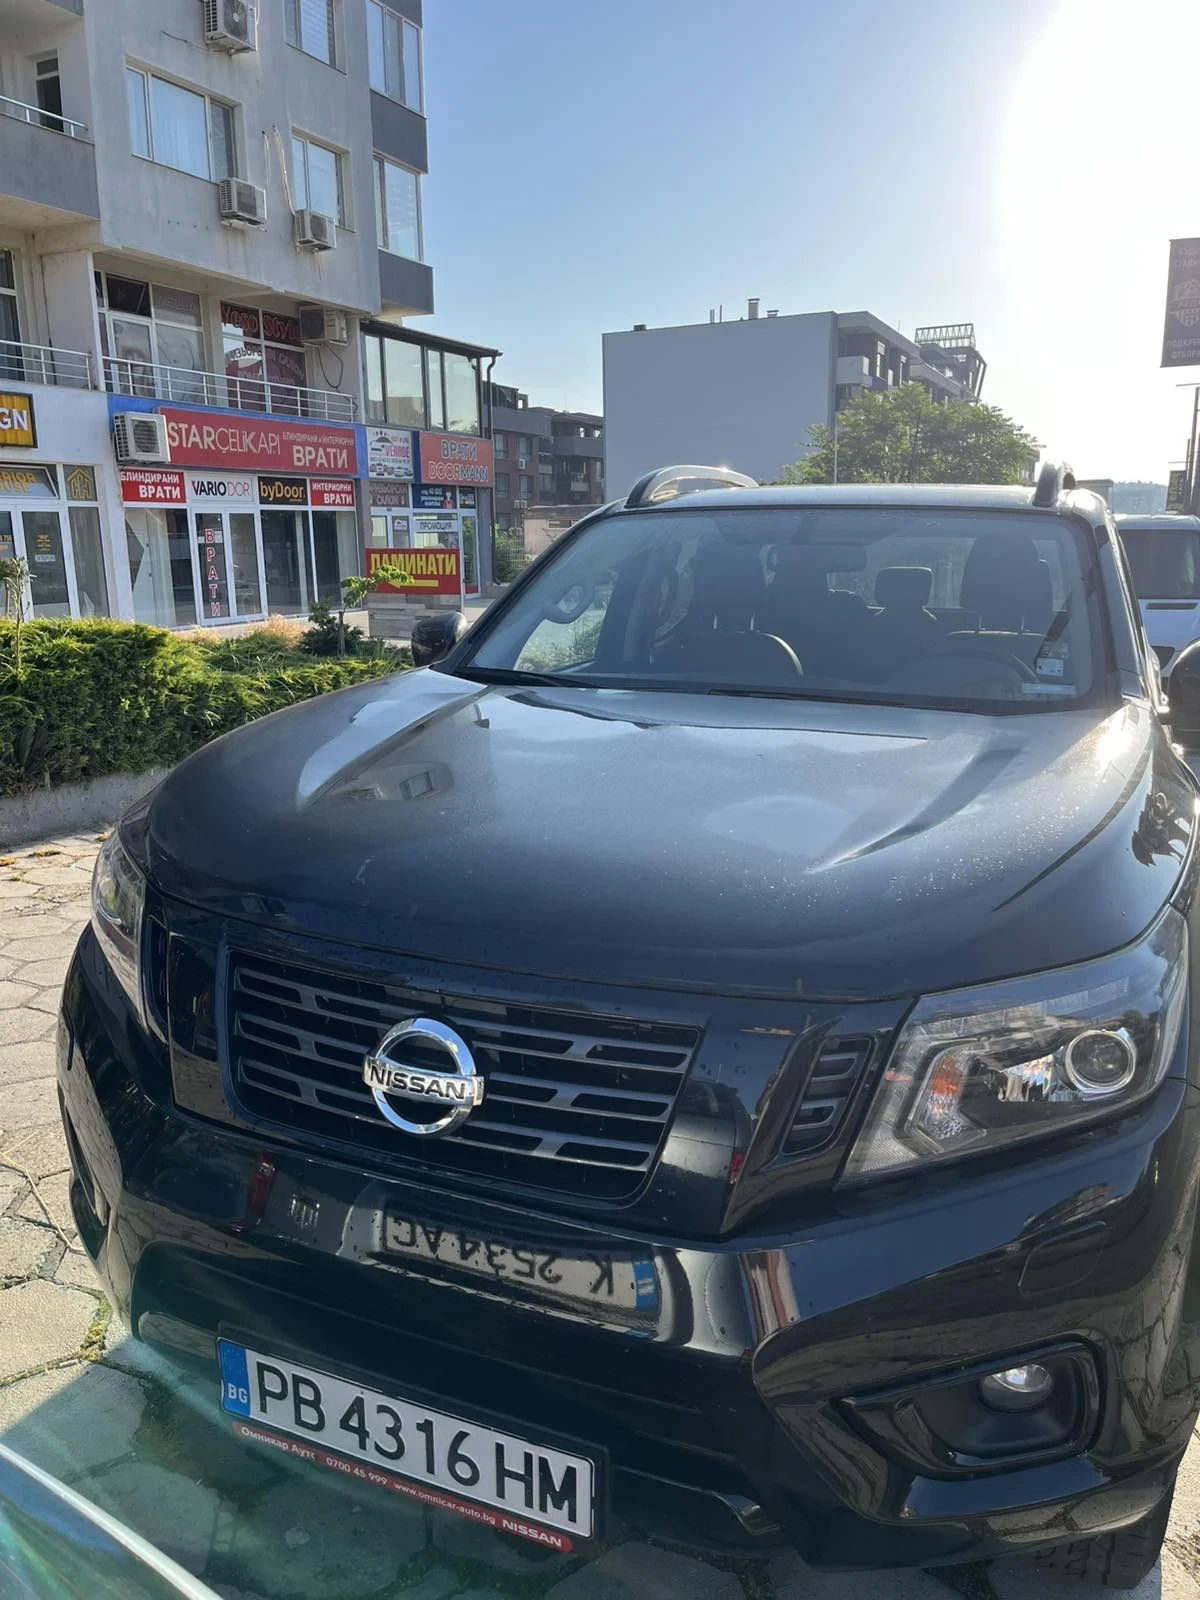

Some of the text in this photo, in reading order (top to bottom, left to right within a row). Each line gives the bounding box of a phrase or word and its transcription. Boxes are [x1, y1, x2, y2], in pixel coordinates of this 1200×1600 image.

[292, 445, 348, 468] ВРАТИ
[440, 439, 477, 462] ВРАТИ
[120, 471, 180, 485] БЛИНДИРАНИ
[428, 461, 489, 482] DOORMANN
[139, 484, 181, 499] ВРАТИ
[312, 482, 352, 493] ИНТЕРИОРНИ
[323, 493, 353, 505] ВРАТИ
[419, 521, 453, 531] ПРОМОЦИЯ
[204, 528, 221, 617] ВРАТИ
[370, 1062, 466, 1101] NISSAN
[227, 1383, 249, 1404] BG
[256, 1361, 577, 1524] PB 4316 HM
[240, 1426, 289, 1451] Омникар
[326, 1456, 351, 1473] 0700
[353, 1467, 366, 1479] 45
[368, 1472, 388, 1486] 999
[394, 1482, 496, 1525] www.omnicar-auto.bg
[502, 1519, 562, 1548] NISSAN
